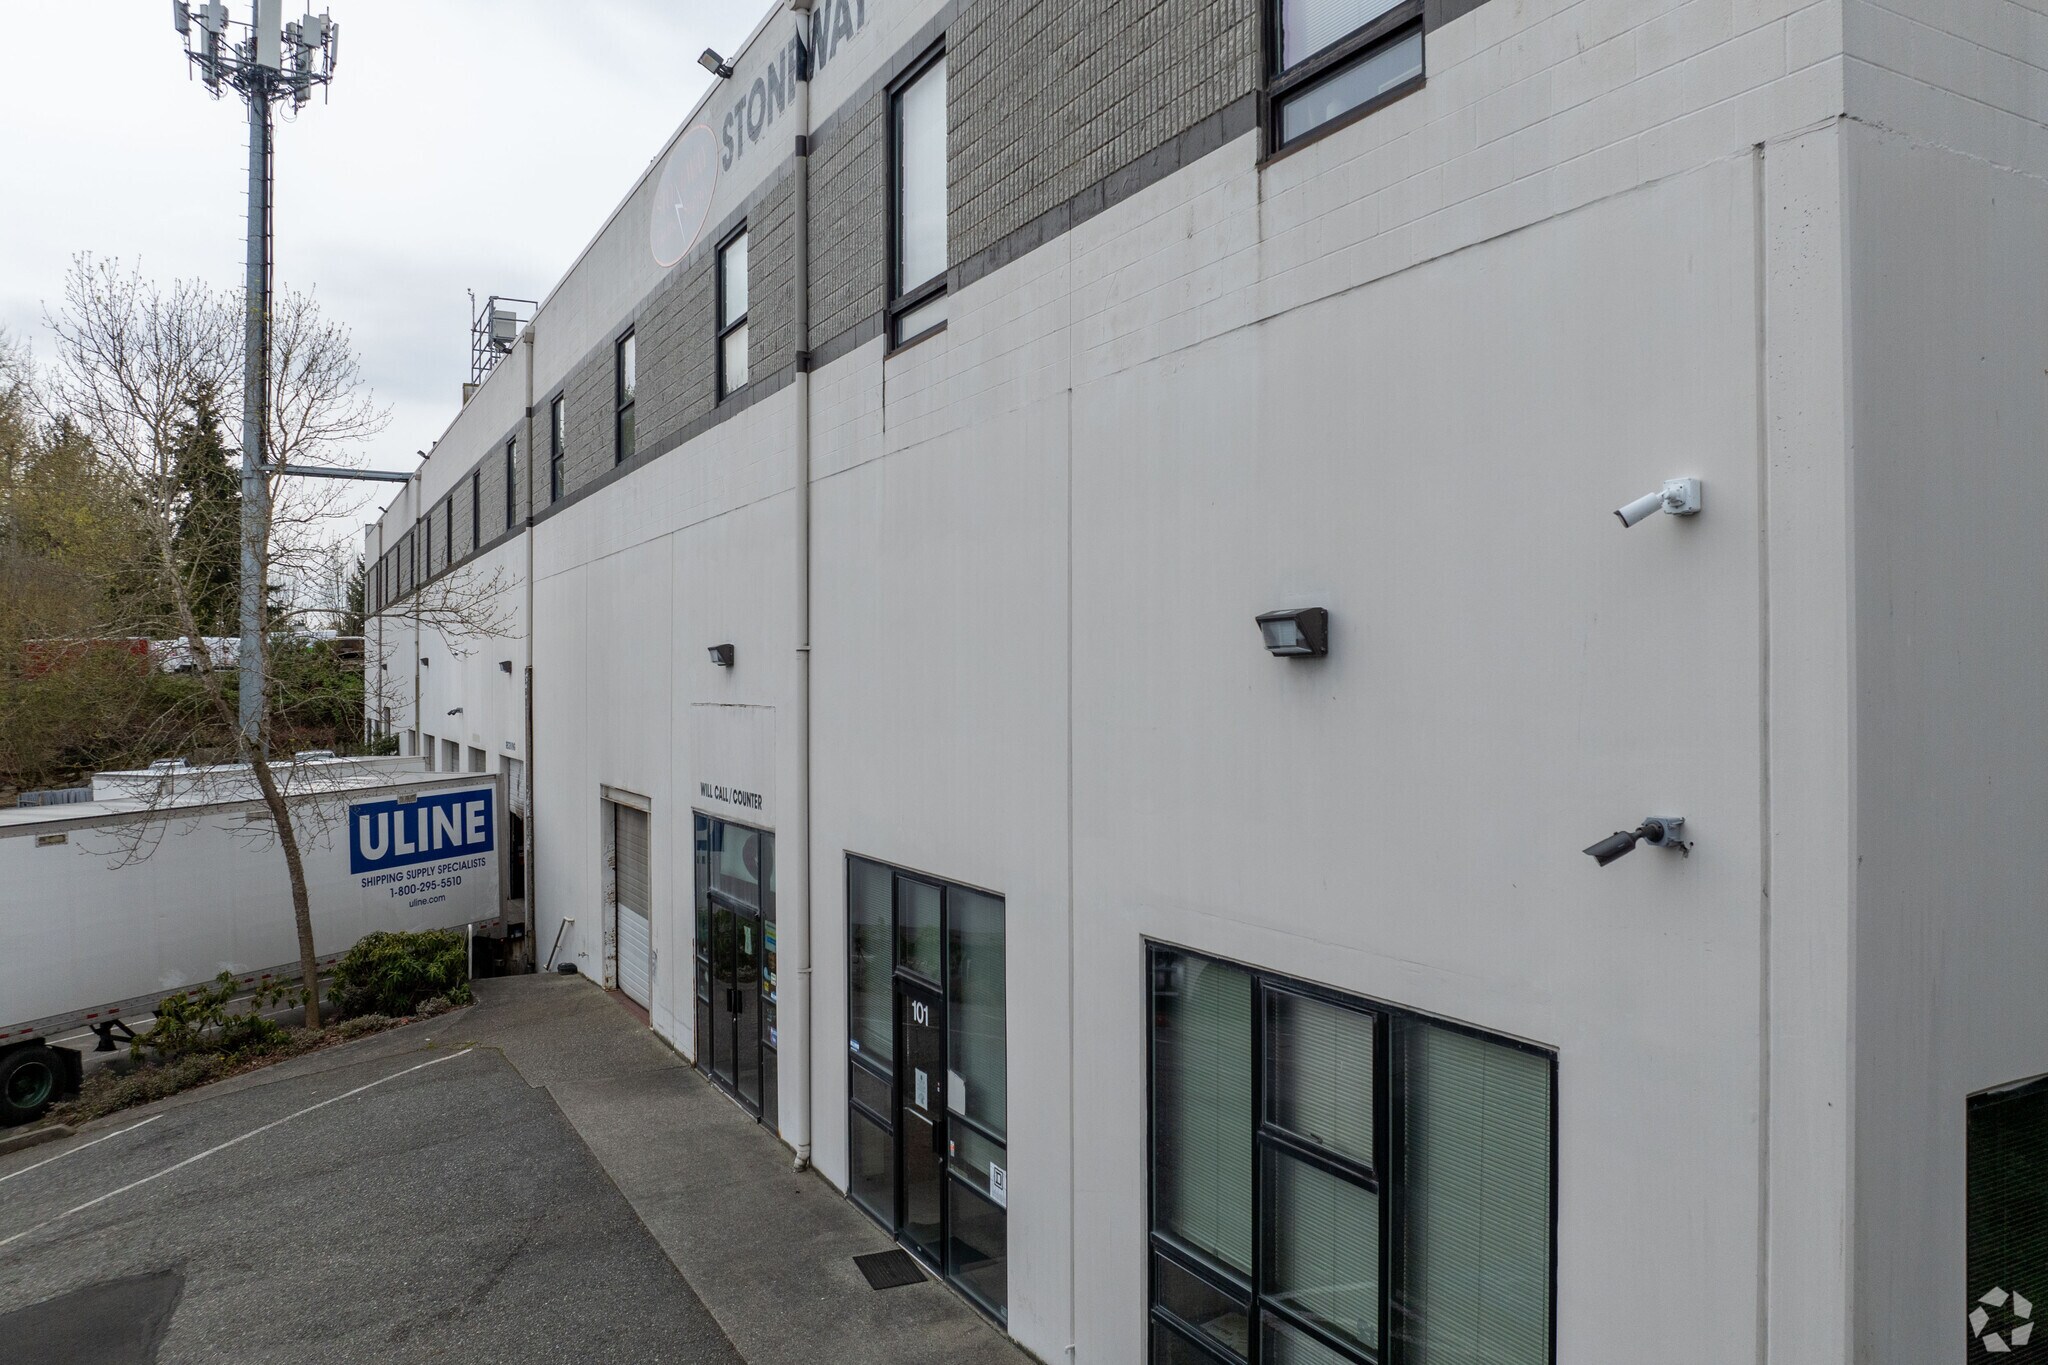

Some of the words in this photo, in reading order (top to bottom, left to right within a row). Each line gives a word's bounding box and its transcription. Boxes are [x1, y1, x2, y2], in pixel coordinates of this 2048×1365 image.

[700, 782, 713, 798] WILL
[359, 800, 486, 861] ULINE
[361, 872, 404, 888] SHIPPING
[406, 866, 435, 880] SUPPLY
[437, 857, 487, 875] SPECIALISTS
[390, 875, 462, 898] 1-800-295-5510
[409, 894, 446, 908] uline.com
[912, 1000, 929, 1027] 101
